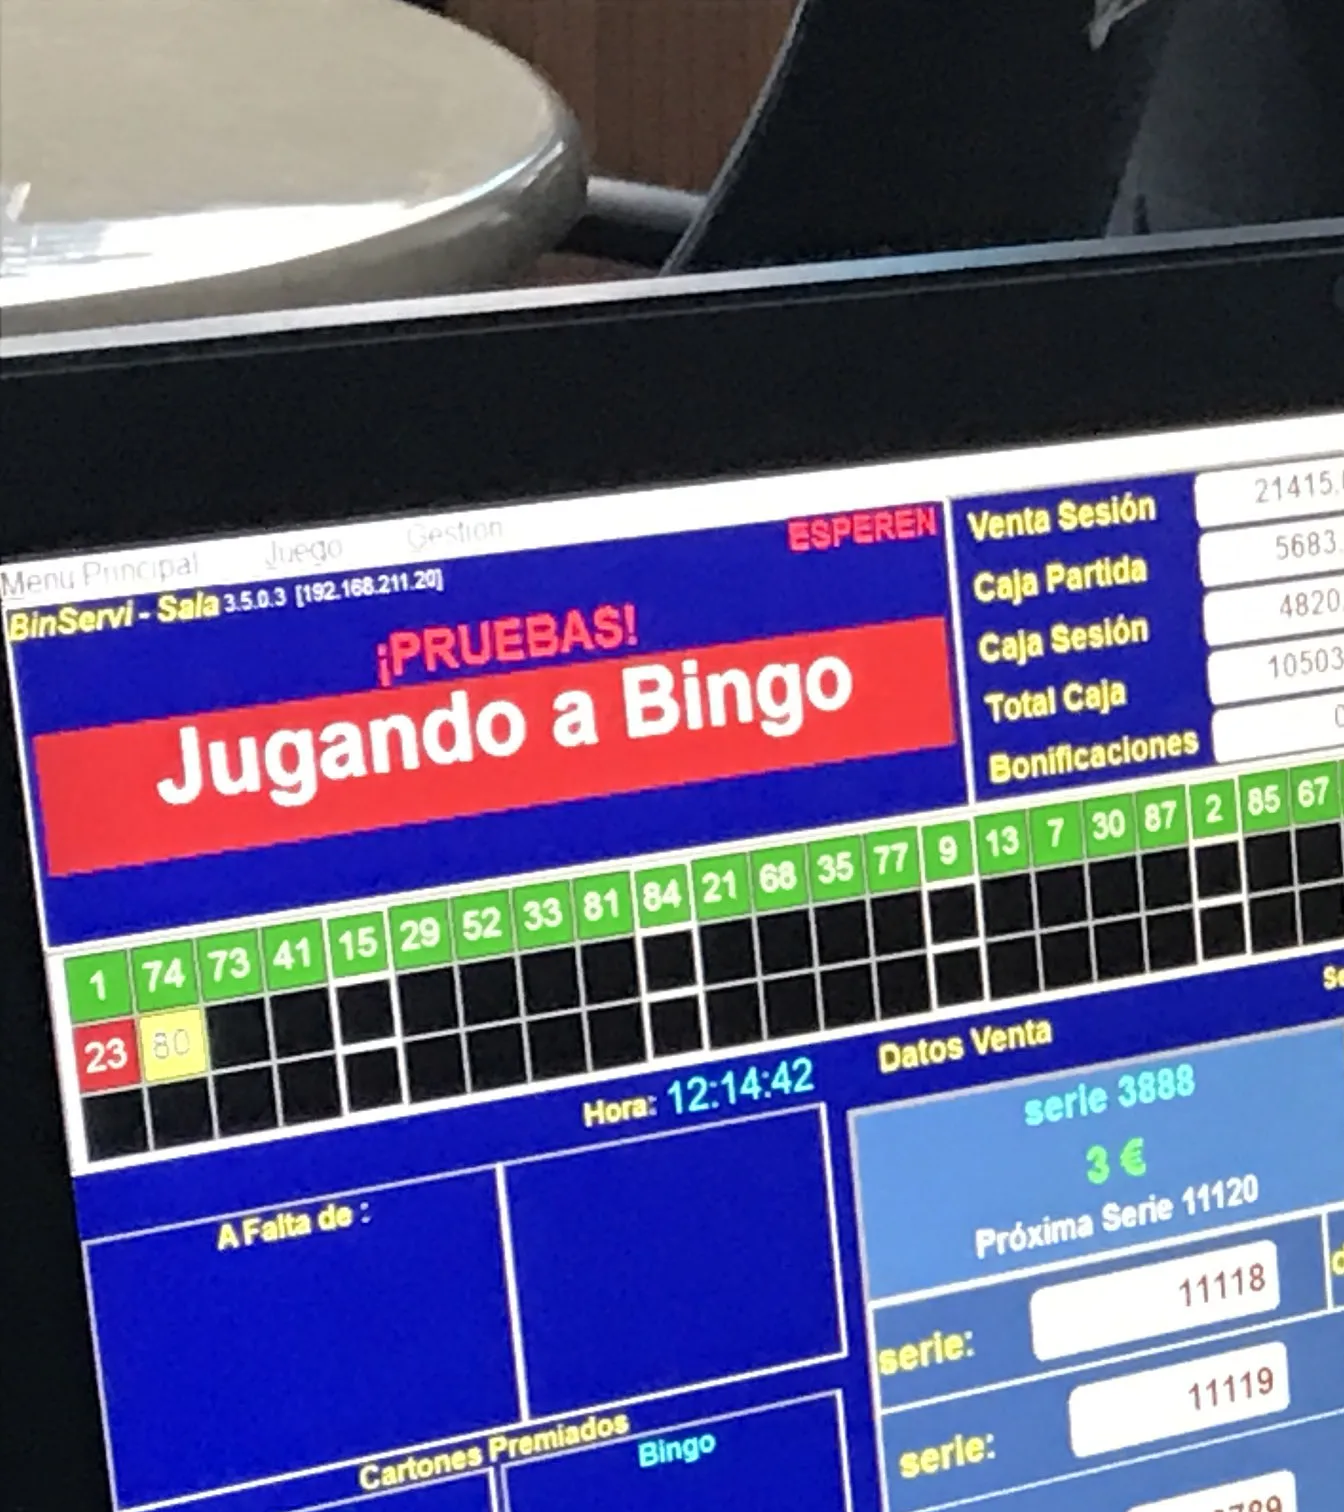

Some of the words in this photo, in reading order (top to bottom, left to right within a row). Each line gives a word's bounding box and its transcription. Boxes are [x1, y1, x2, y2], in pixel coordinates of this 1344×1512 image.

[788, 508, 938, 553] ESPEREN
[968, 505, 1051, 542] Venta
[1057, 490, 1156, 529] Sesión
[157, 591, 220, 624] Sala
[224, 587, 288, 613] 3.5.0.3
[973, 568, 1041, 606] Caja
[1047, 554, 1148, 592] Partida
[377, 605, 638, 687] ¡PRUEBAS!
[978, 630, 1044, 667] Caja
[1052, 613, 1150, 653] Sesión
[984, 688, 1056, 725] Total
[1062, 679, 1127, 717] Caja
[156, 688, 527, 806] Jugando
[552, 690, 599, 746] a
[623, 655, 855, 739] Bingo
[989, 727, 1200, 785] Bonificaciones
[142, 961, 186, 992] 74
[462, 908, 501, 941] 52
[643, 880, 683, 912] 84
[1091, 810, 1126, 841] 30
[85, 1036, 128, 1072] 23
[878, 1034, 963, 1073] Datos
[970, 1017, 1053, 1055] Venta
[583, 1093, 657, 1128] Hora:
[667, 1058, 815, 1115] 12:14:42
[1024, 1083, 1107, 1127] serie
[1117, 1064, 1196, 1106] 3888
[1086, 1147, 1110, 1184] 3
[1121, 1137, 1147, 1178] €
[217, 1225, 239, 1250] A
[243, 1209, 312, 1247] Falta
[317, 1202, 352, 1231] de
[976, 1215, 1093, 1260] Próxima
[1102, 1195, 1173, 1232] Serie
[1181, 1174, 1260, 1216] 11120
[878, 1330, 974, 1376] serie:
[1179, 1262, 1266, 1309] 11118
[637, 1431, 716, 1470] Bingo
[899, 1432, 996, 1479] serie:
[1188, 1366, 1275, 1412] 11119
[359, 1443, 482, 1491] Cartones
[490, 1412, 630, 1463] Premiados
